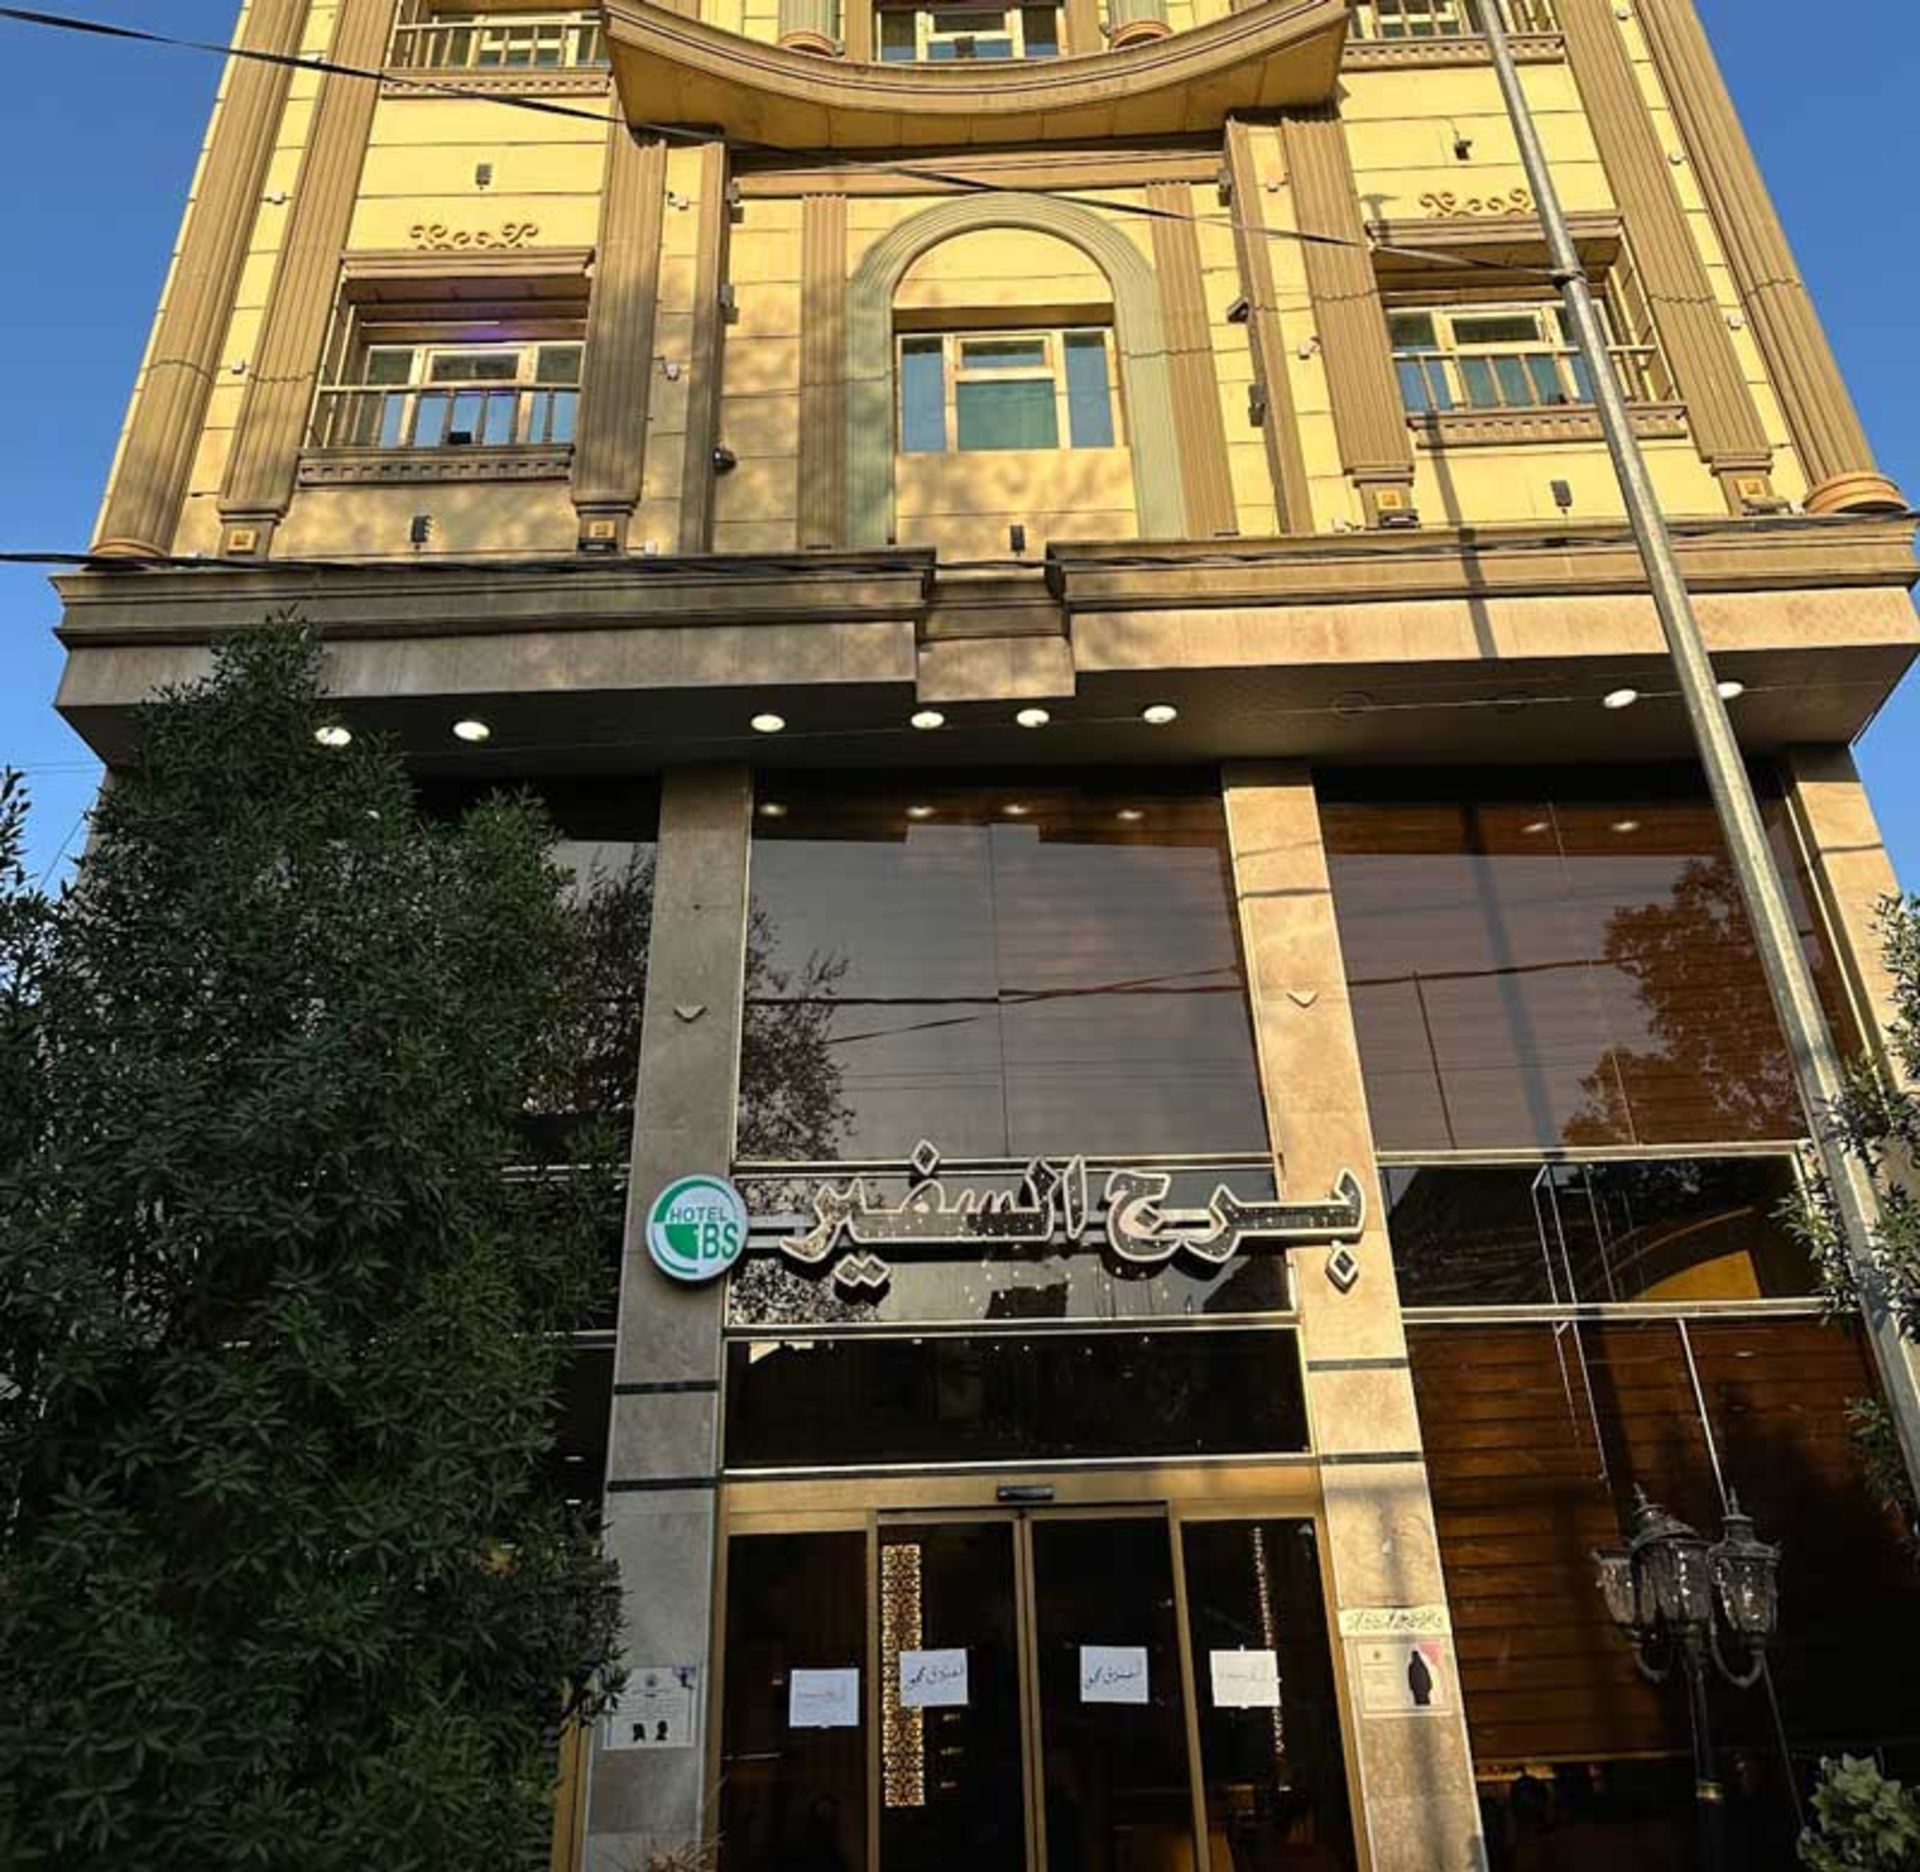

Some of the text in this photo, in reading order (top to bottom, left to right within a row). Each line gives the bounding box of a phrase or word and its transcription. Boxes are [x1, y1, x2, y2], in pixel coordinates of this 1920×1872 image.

[669, 1206, 729, 1222] HOTEL
[779, 1139, 1366, 1287] برج السفير
